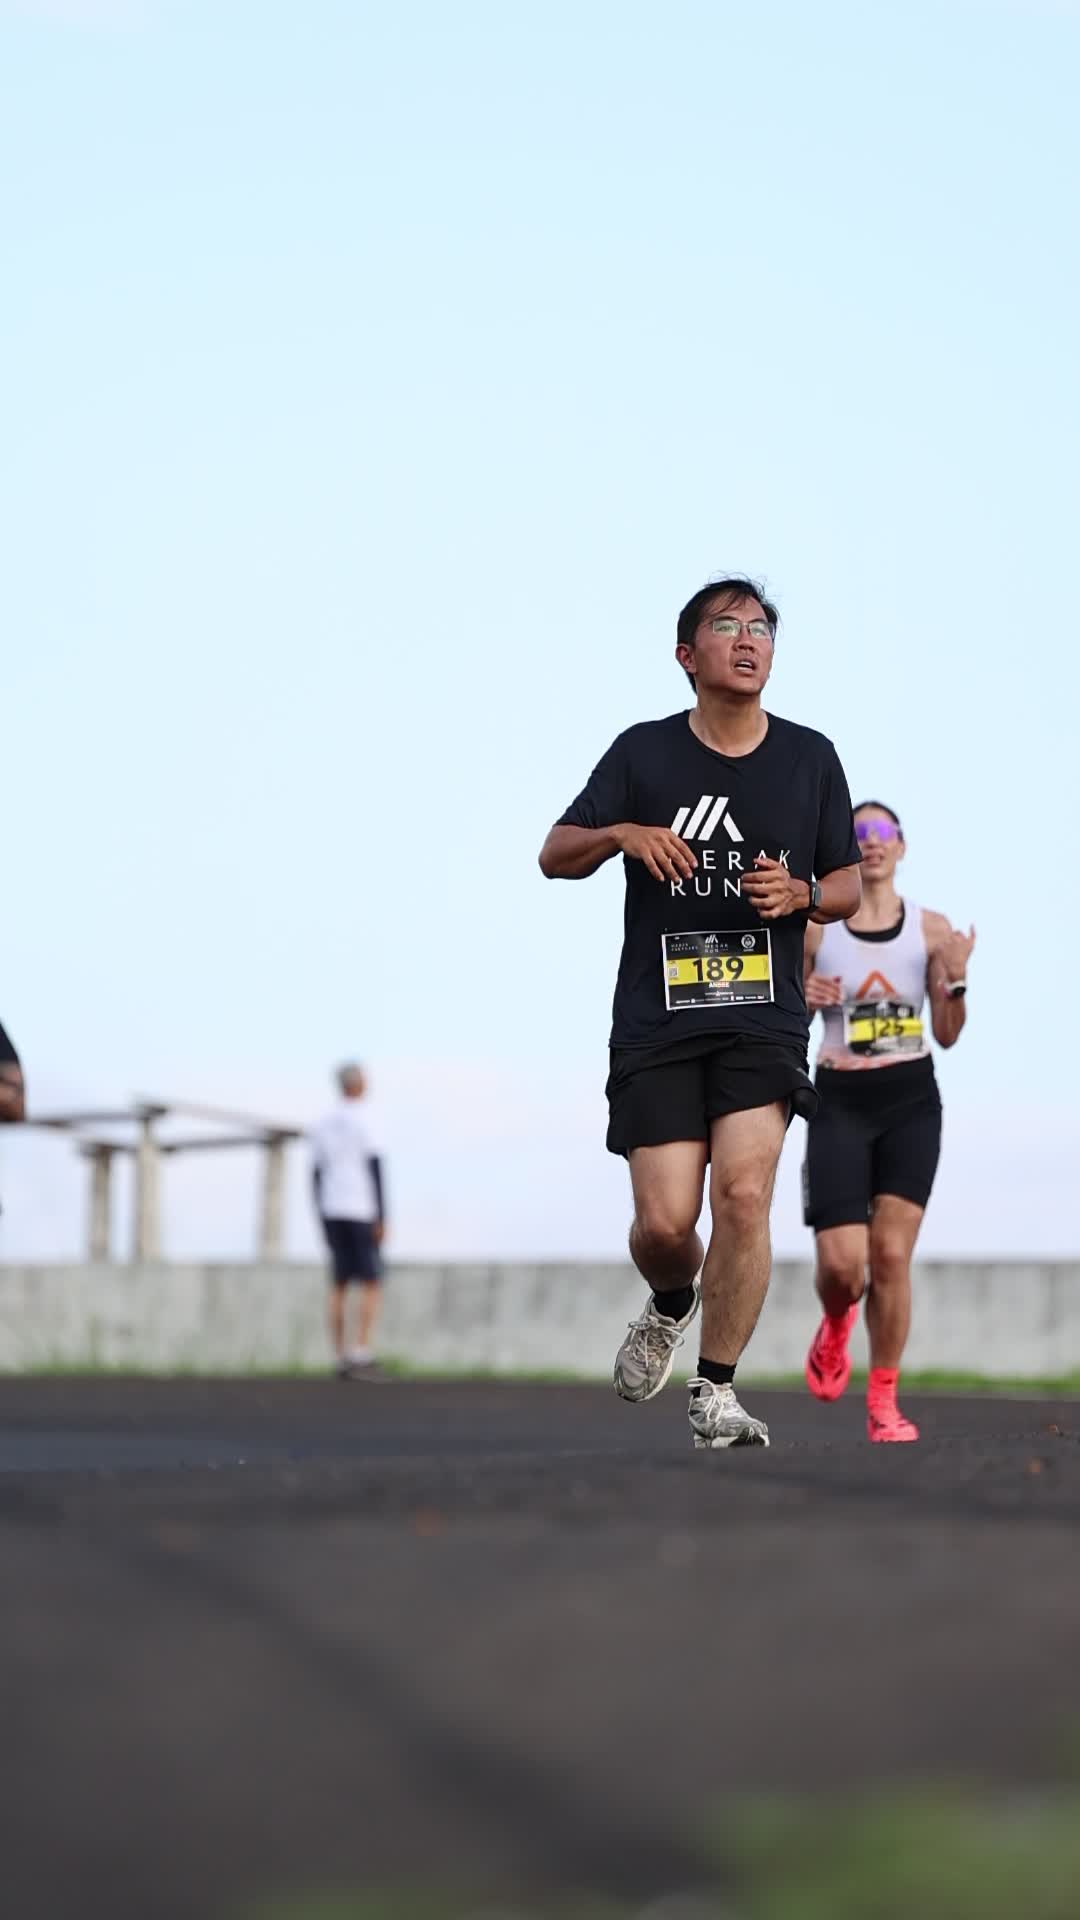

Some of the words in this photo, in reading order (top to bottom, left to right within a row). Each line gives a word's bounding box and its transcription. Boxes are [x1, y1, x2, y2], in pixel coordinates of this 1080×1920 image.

[669, 849, 791, 870] ERAK
[670, 876, 741, 897] RUN
[692, 956, 744, 982] 189
